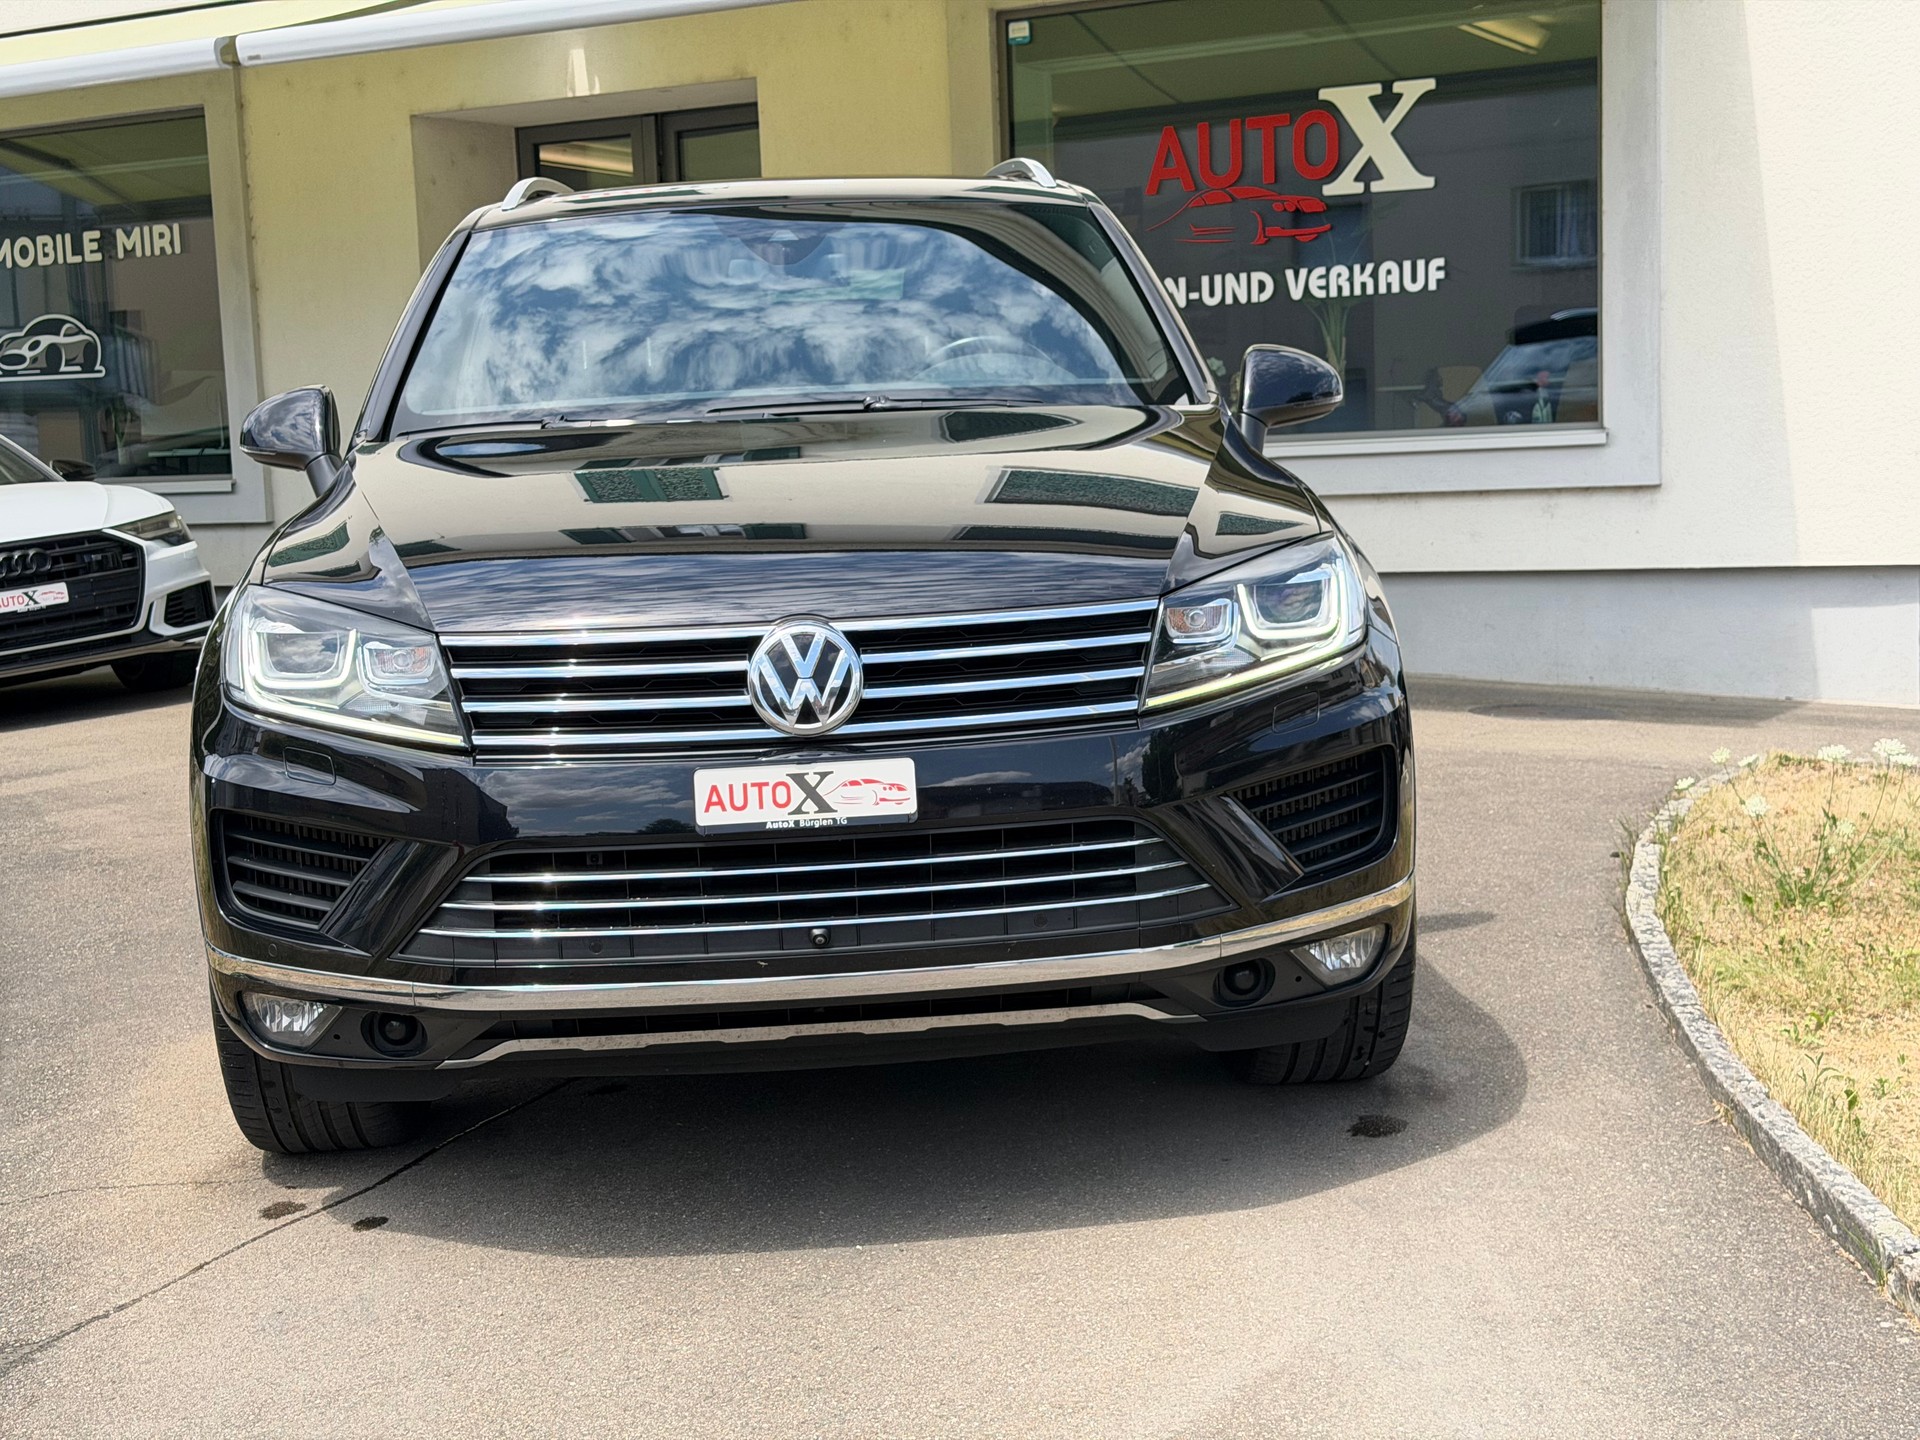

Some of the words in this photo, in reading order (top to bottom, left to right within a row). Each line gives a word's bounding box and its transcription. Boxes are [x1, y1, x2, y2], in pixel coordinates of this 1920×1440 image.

[116, 222, 181, 259] MIRI
[1285, 257, 1446, 301] VERKAUF
[0, 590, 41, 608] UTOX
[766, 821, 795, 829] AutoX
[835, 817, 847, 825] TG
